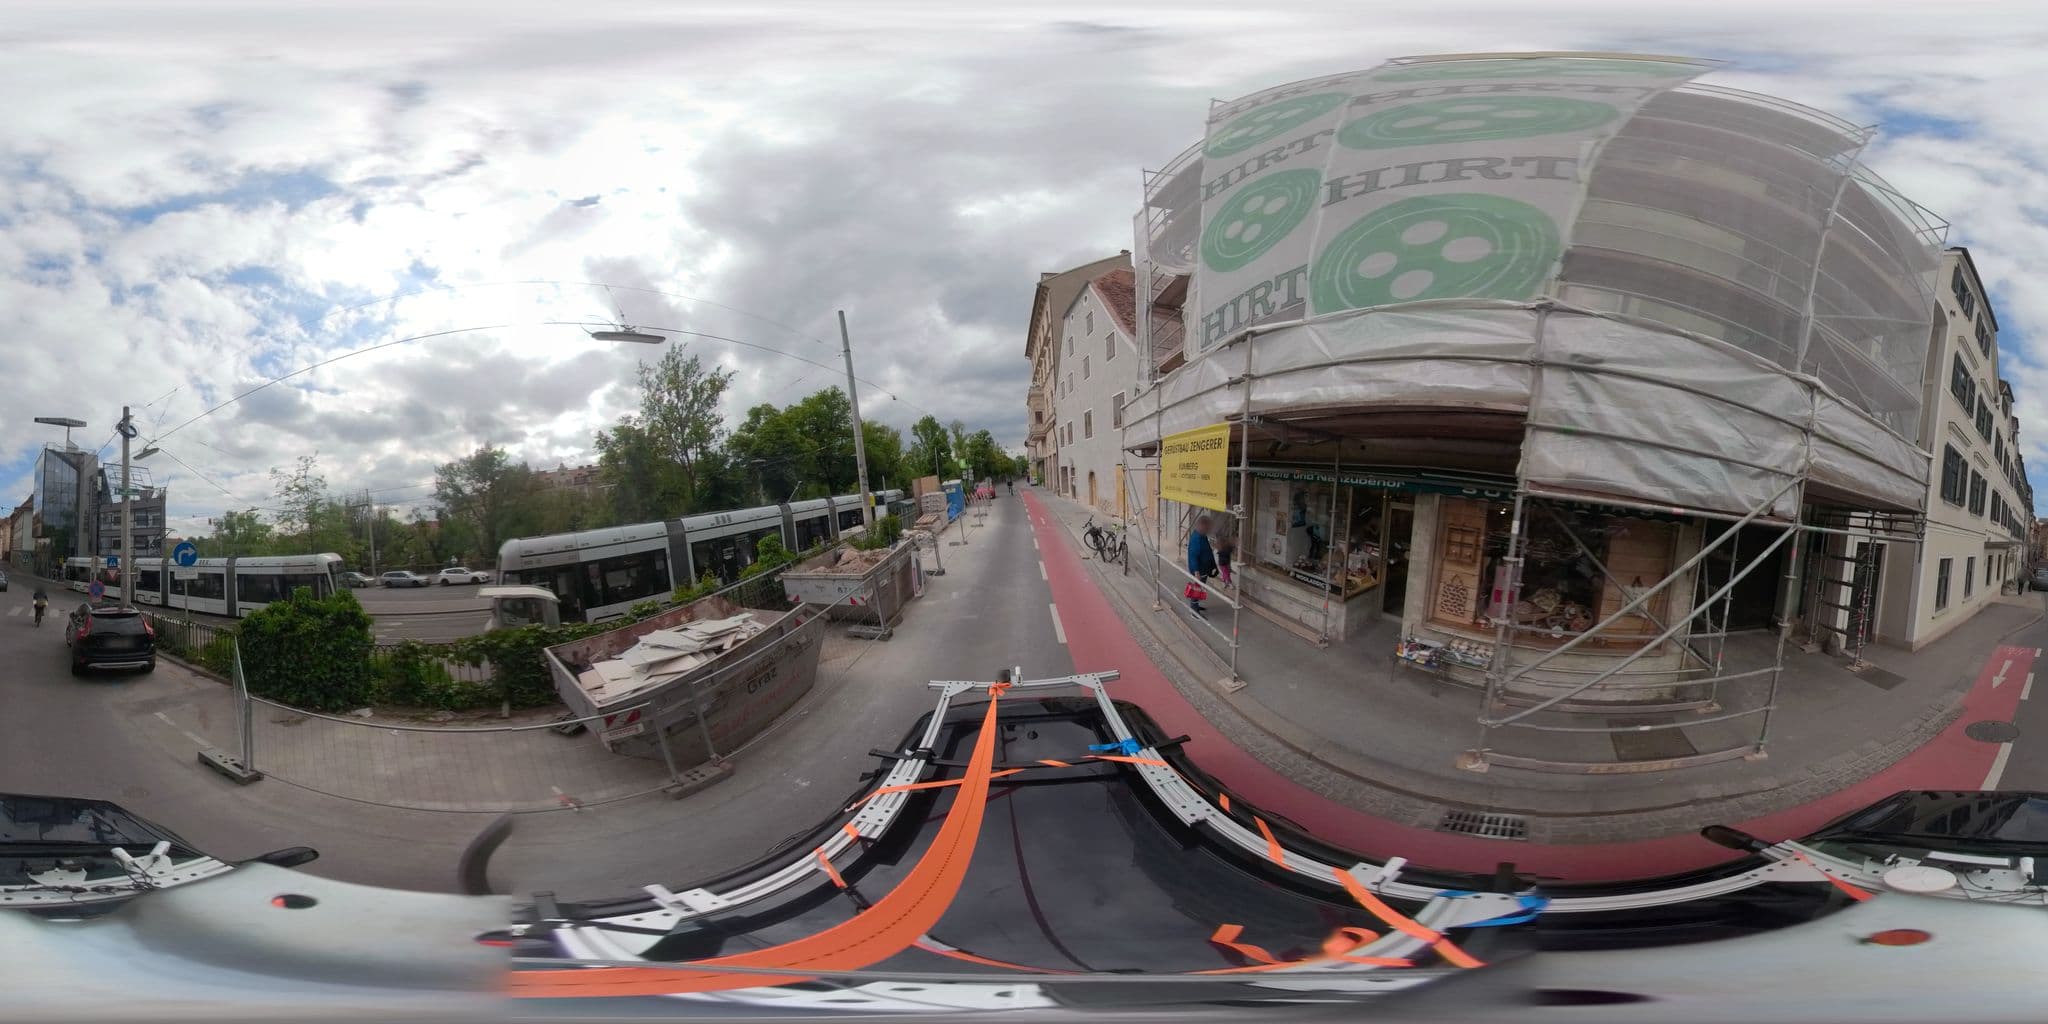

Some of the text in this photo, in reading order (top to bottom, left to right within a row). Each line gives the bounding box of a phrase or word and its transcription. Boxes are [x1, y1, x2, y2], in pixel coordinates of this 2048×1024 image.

[1200, 129, 1336, 202] HIRT
[1321, 155, 1578, 208] HIRT
[1200, 263, 1308, 348] HIRT
[747, 666, 777, 694] Graz
